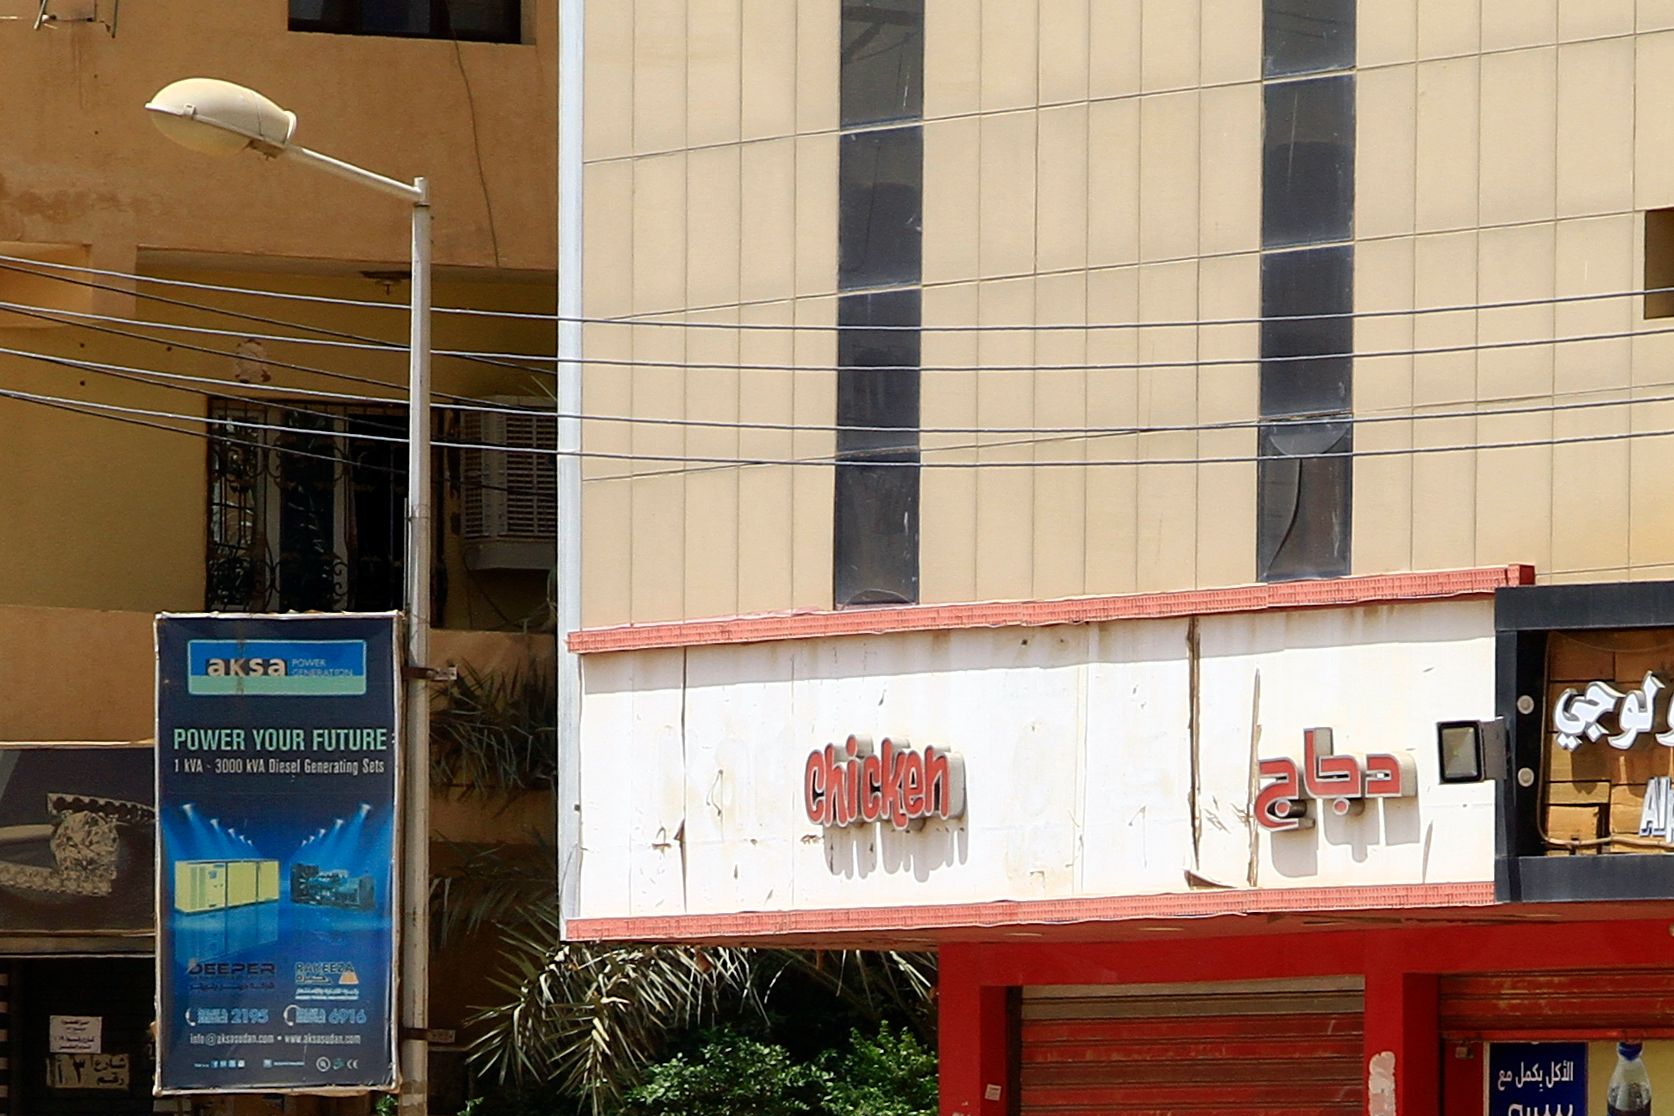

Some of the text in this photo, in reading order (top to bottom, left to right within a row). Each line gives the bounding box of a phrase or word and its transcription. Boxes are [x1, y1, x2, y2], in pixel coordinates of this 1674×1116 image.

[206, 657, 288, 678] aksa
[173, 728, 388, 751] POWER YOUR FUTURE
[174, 759, 180, 773] 1
[184, 758, 203, 773] kVA
[215, 758, 243, 774] 3000
[246, 758, 266, 773] kVA
[268, 758, 301, 774] Diesel
[304, 758, 359, 776] Generating
[362, 757, 385, 774] Sets
[804, 732, 957, 829] Chicken
[1254, 726, 1406, 832] دجاج
[328, 1009, 367, 1024] 6916
[1497, 1070, 1513, 1091] مع
